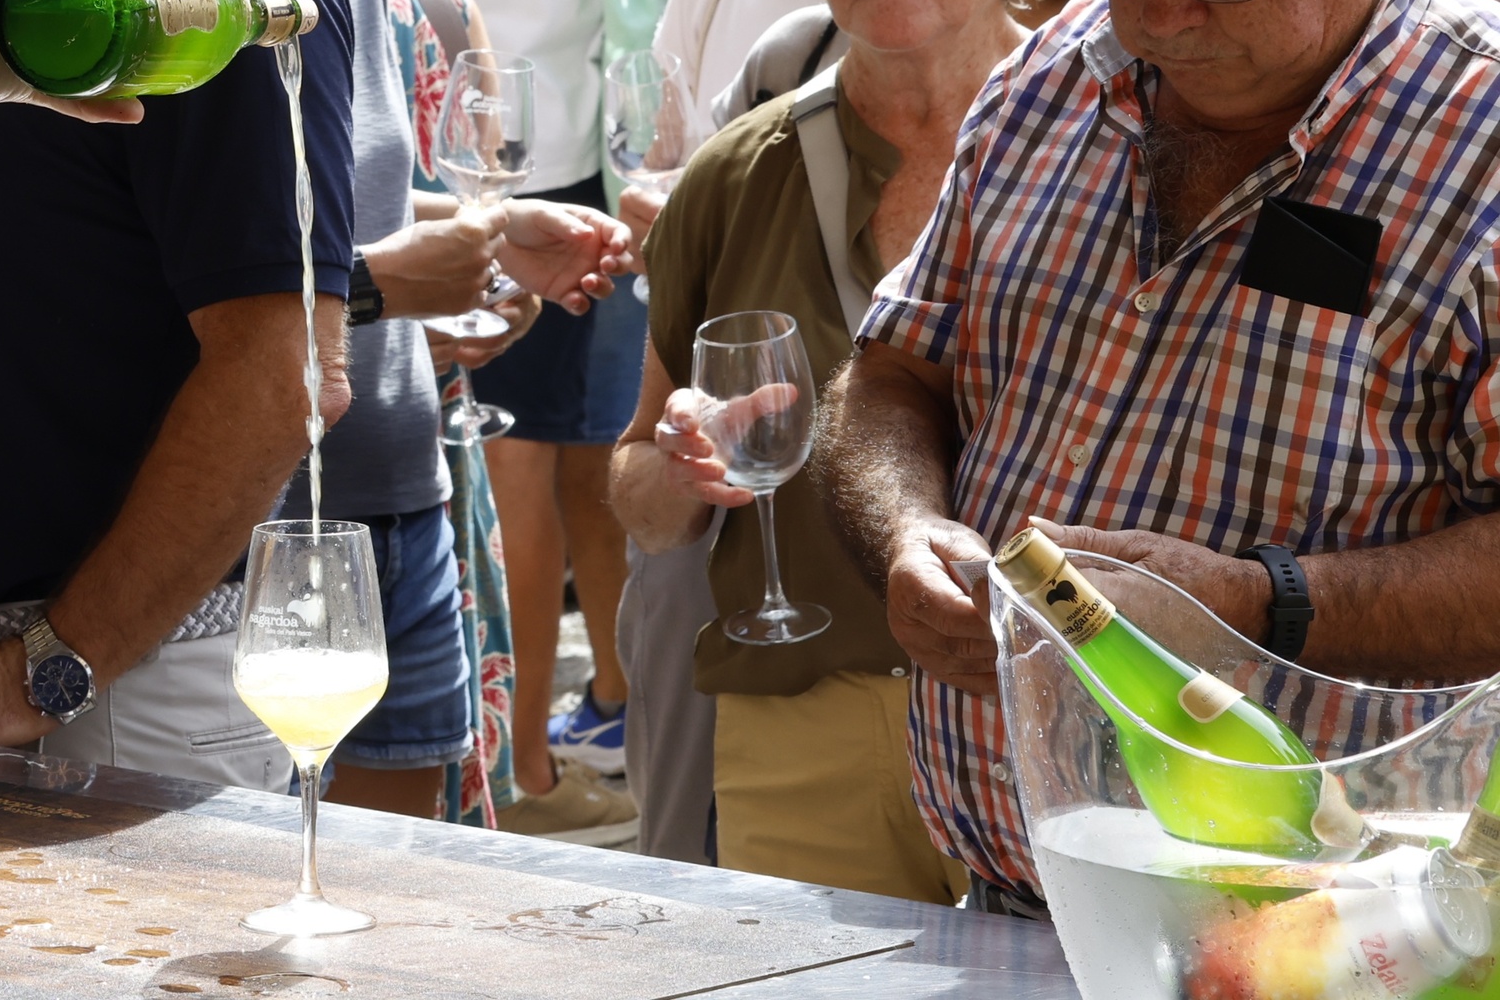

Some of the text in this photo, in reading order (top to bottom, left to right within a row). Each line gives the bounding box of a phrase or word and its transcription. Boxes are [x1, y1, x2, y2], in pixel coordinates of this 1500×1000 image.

[249, 613, 299, 628] sagardoa
[259, 606, 283, 615] euskal
[1062, 598, 1102, 637] sagardoa
[1066, 600, 1088, 622] euskal
[1359, 932, 1409, 996] Zelaia
